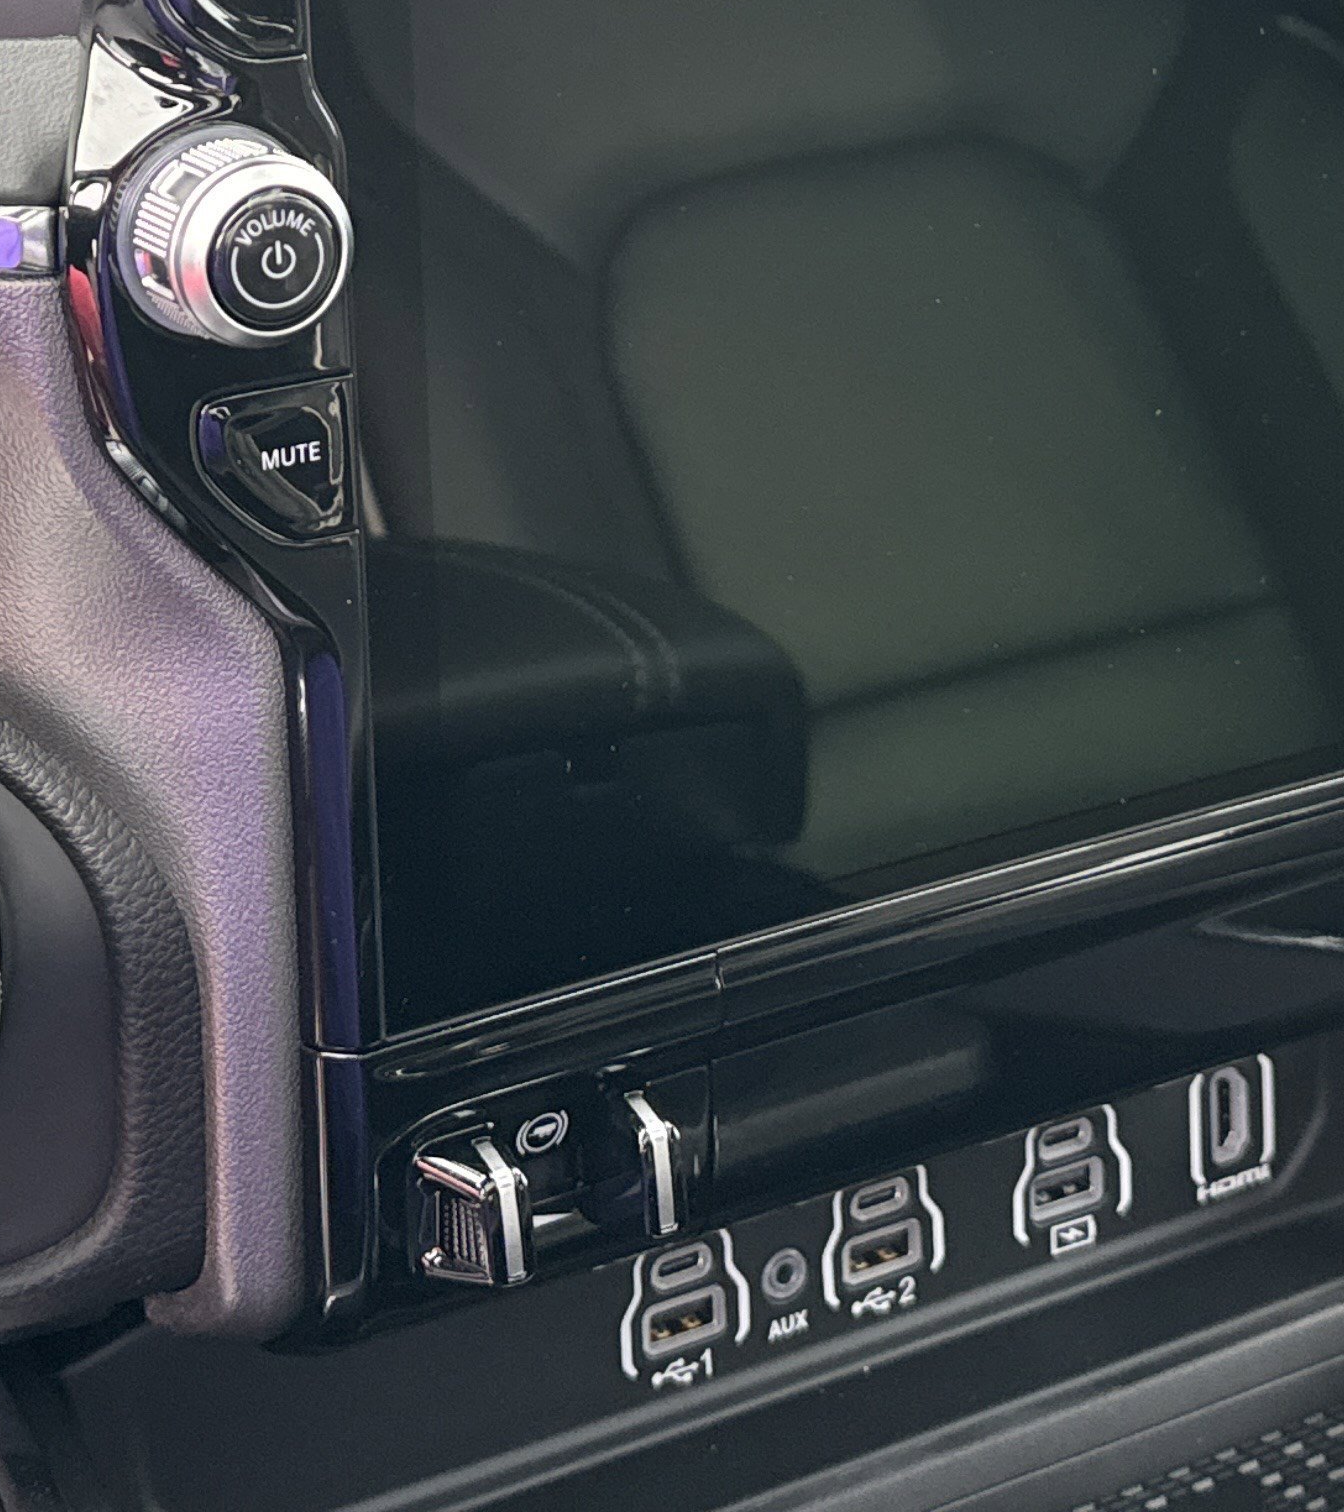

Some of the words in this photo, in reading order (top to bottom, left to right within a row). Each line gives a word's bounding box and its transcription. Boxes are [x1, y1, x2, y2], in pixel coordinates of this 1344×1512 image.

[234, 208, 317, 248] VOLUME
[261, 441, 321, 471] MUTE
[899, 1275, 916, 1306] 2
[768, 1309, 810, 1341] AUX
[703, 1347, 714, 1377] 1
